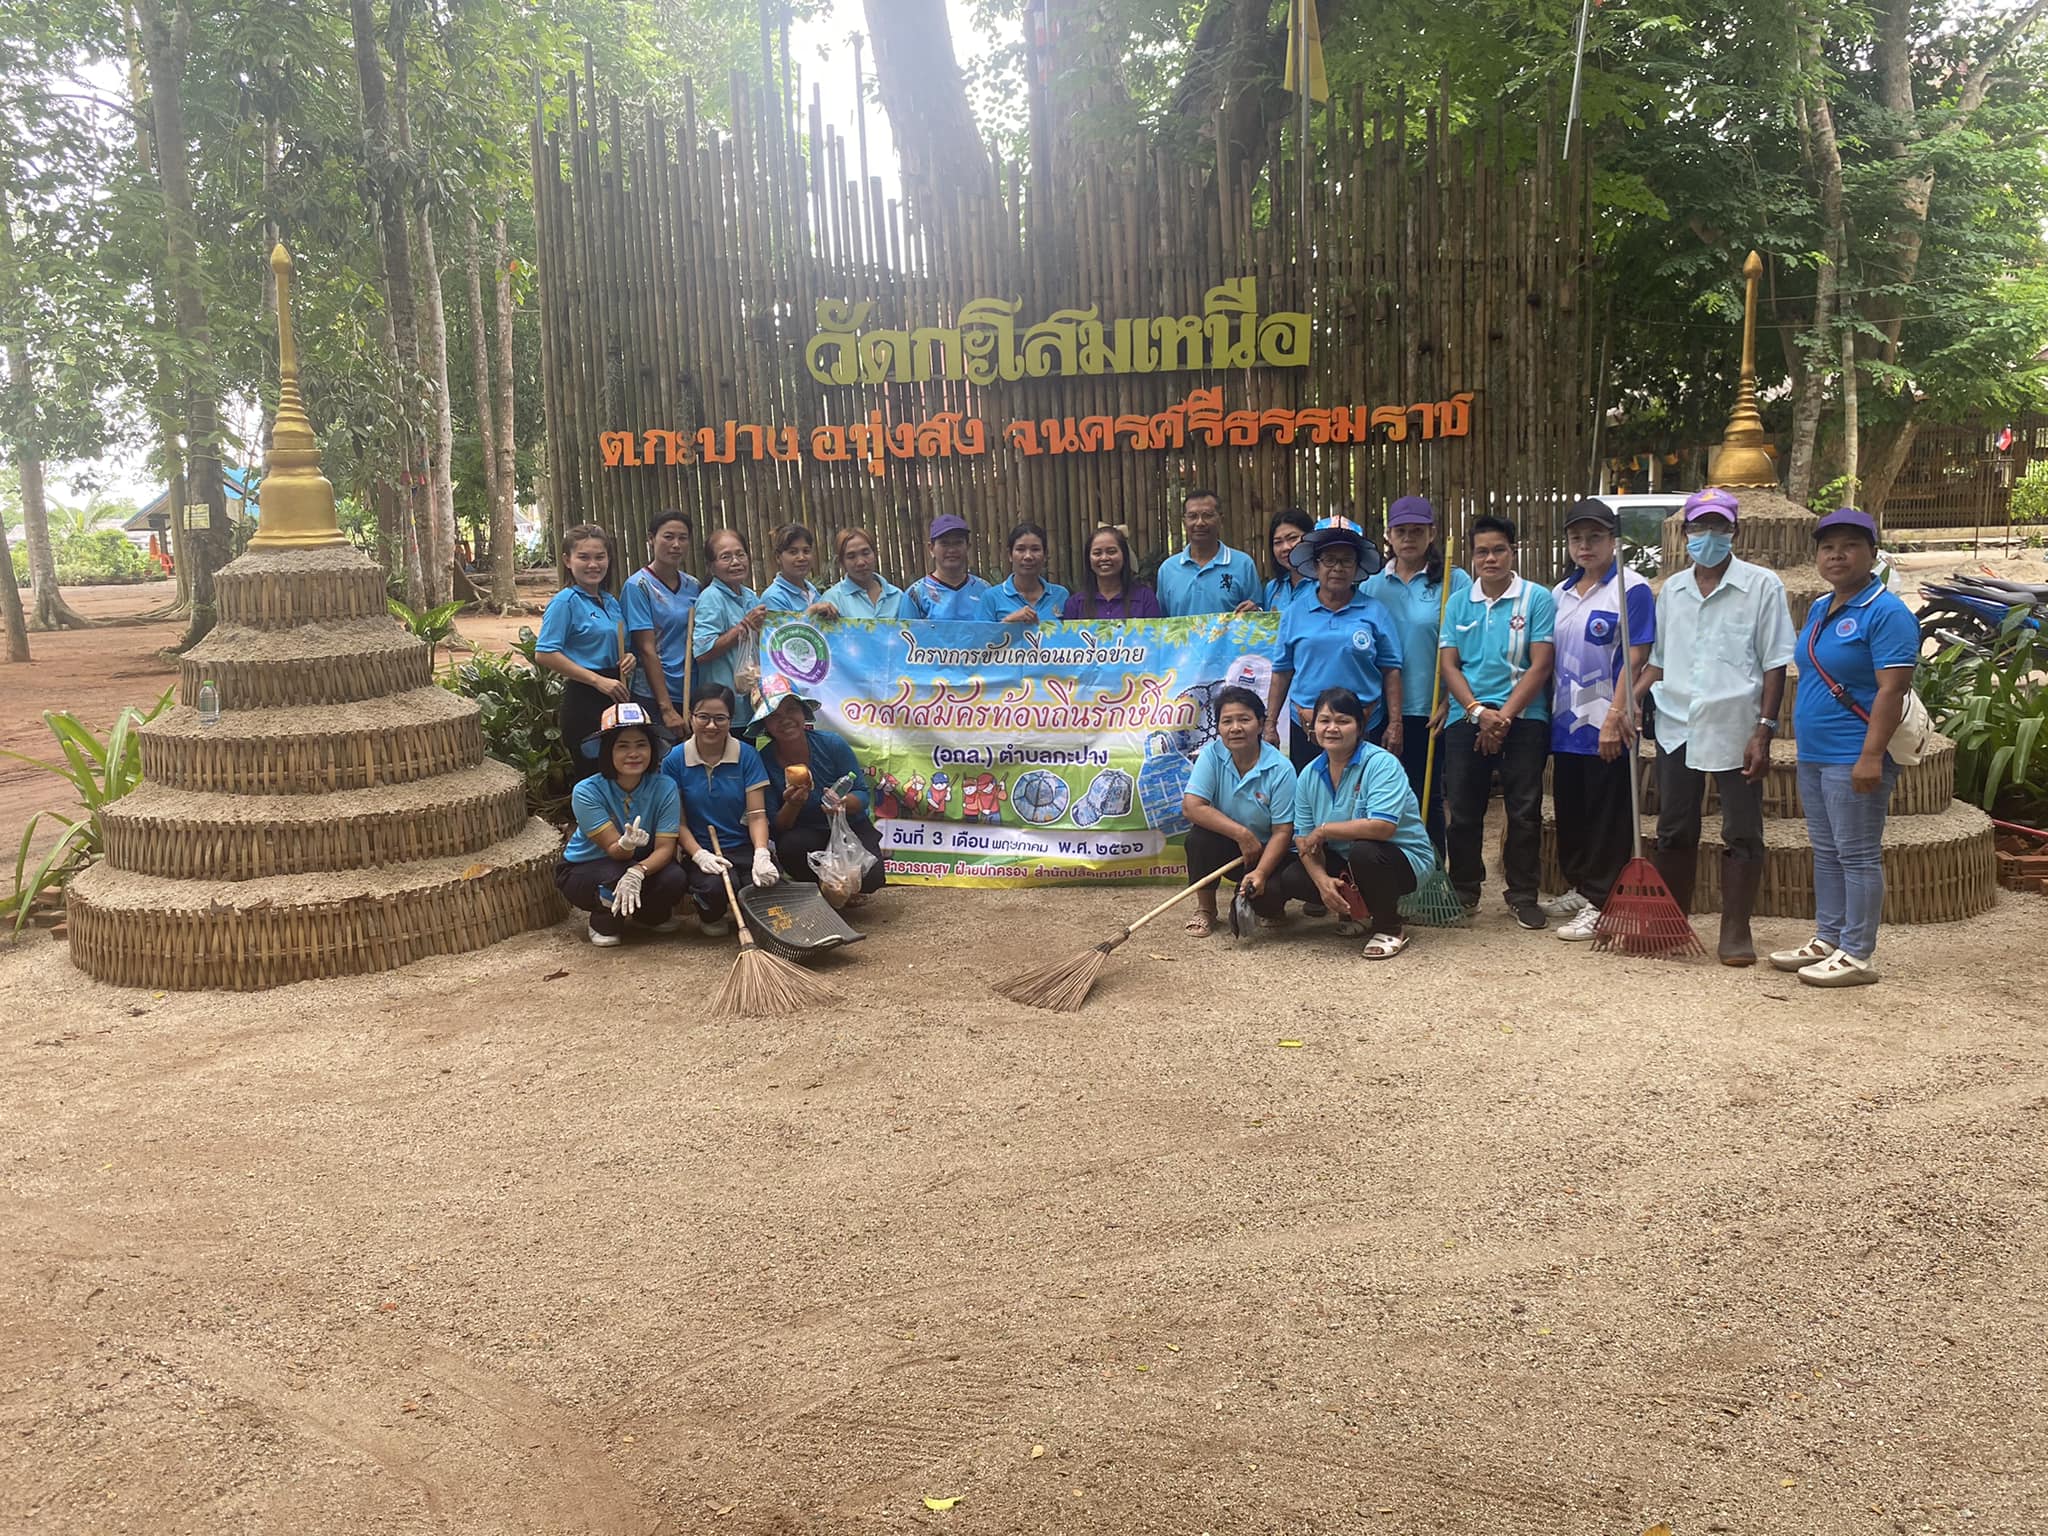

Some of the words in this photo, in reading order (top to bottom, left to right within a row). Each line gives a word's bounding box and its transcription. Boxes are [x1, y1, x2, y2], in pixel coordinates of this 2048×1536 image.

[806, 276, 1312, 386] วัดกะโสมเหนือ
[600, 419, 799, 467] ต.กะปาง
[810, 409, 986, 477] อ.ทุ่งสง
[901, 631, 1145, 664] โครงการขับเคลื่อนเครือข่าย
[844, 671, 1195, 728] อาสาสมัครท้องถิ่นรักษ์โลก
[933, 745, 993, 767] (อถล.)
[1000, 743, 1108, 765] ตำบลกะปาง
[892, 824, 925, 845] วันที่
[932, 831, 943, 845] 3
[952, 831, 989, 849] เดือน
[992, 839, 1049, 853] พฤษภาคม
[1058, 841, 1091, 855] พ.ศ.
[1095, 841, 1144, 856] ๒๕๖๖
[955, 860, 1028, 878] ฝ่ายปกครอง
[1150, 864, 1187, 876] เทศบา
